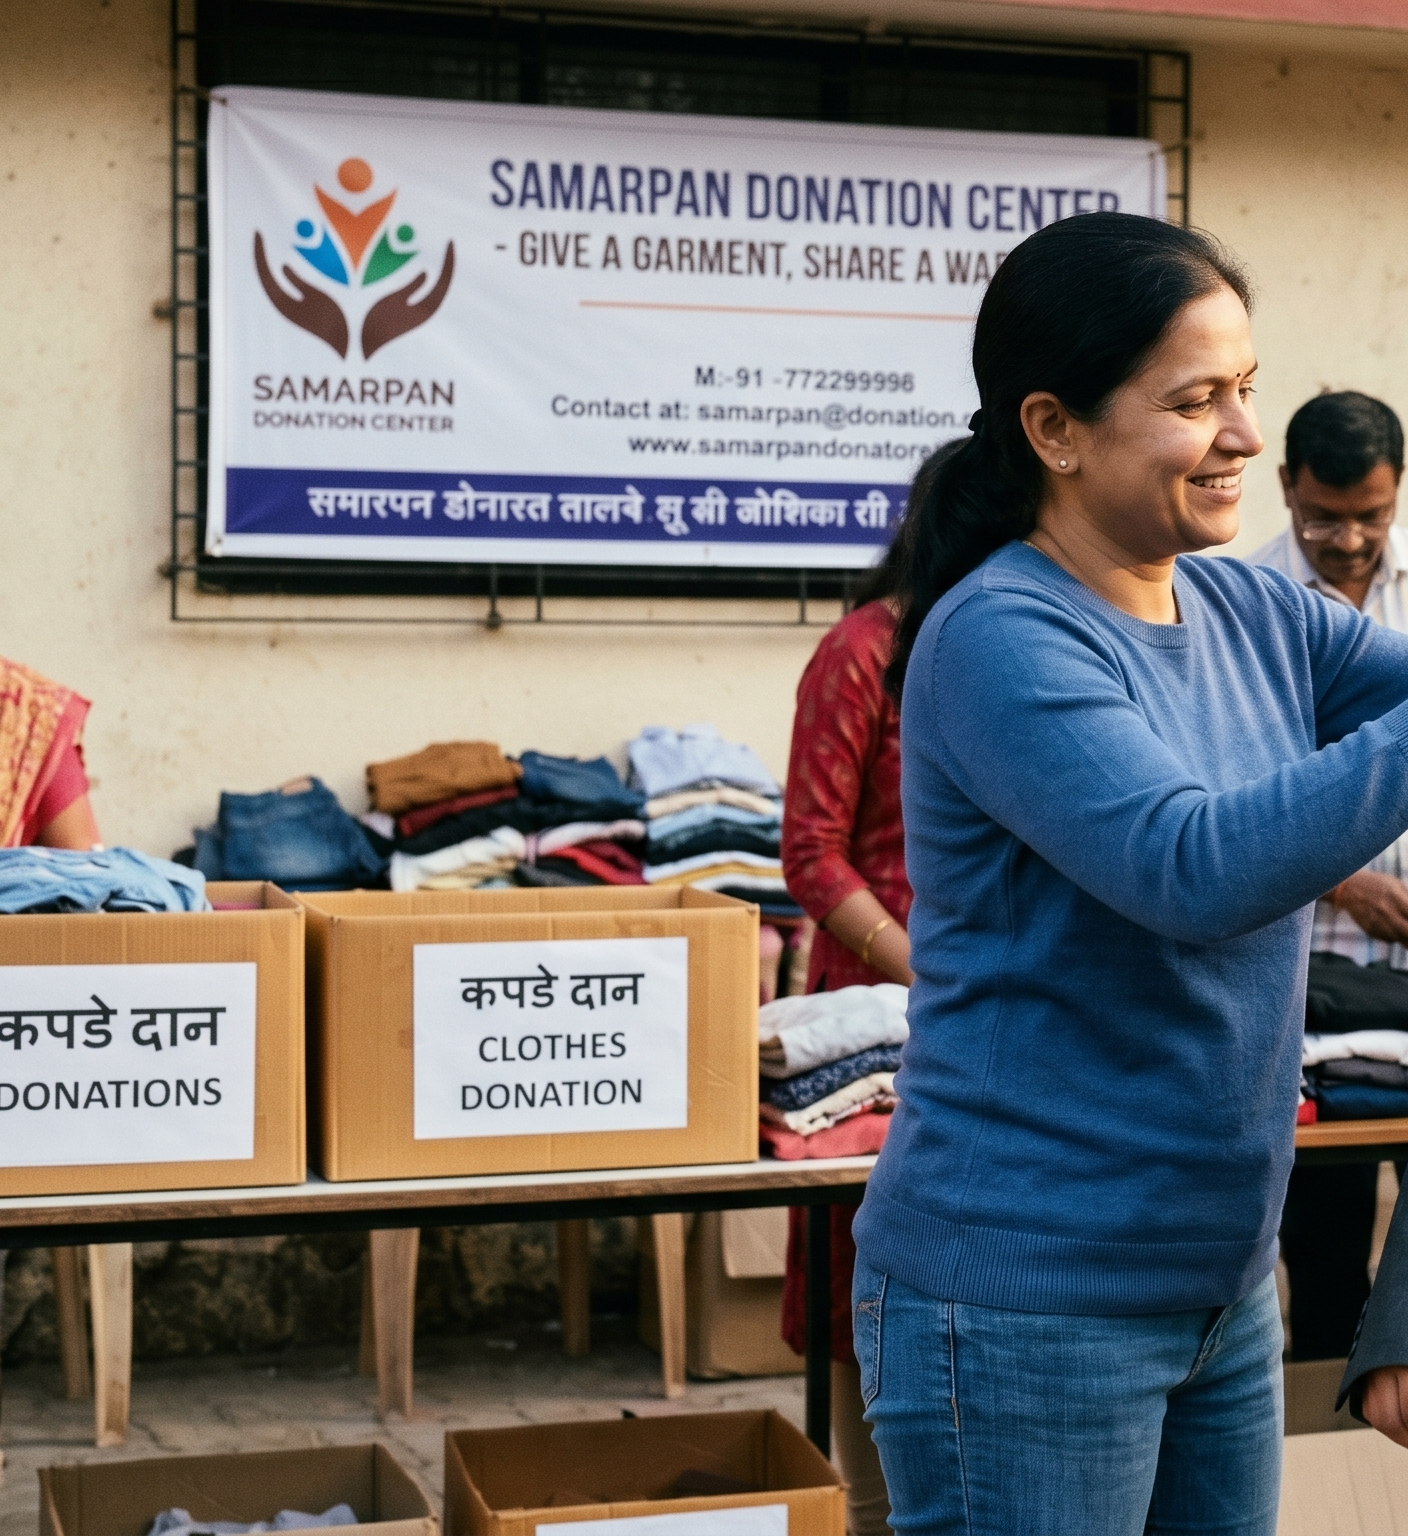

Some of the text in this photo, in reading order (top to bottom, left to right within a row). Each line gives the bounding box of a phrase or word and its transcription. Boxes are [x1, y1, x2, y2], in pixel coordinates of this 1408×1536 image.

[490, 159, 730, 218] SAMARPAN
[746, 173, 952, 229] DONATION
[519, 230, 591, 268] GIVE
[601, 235, 622, 269] A
[633, 235, 793, 283] GARMENT,
[803, 243, 903, 282] SHARE
[914, 248, 936, 285] A
[253, 374, 454, 406] SAMARPAN
[253, 410, 454, 433] DONATION CENTER
[551, 394, 650, 419] Contact
[659, 400, 690, 421] at:
[460, 964, 645, 1010] कपडे दान
[130, 1007, 227, 1051] दान
[478, 1032, 627, 1062] CLOTHES
[0, 1077, 222, 1112] DONATIONS
[461, 1079, 642, 1110] DONATION
